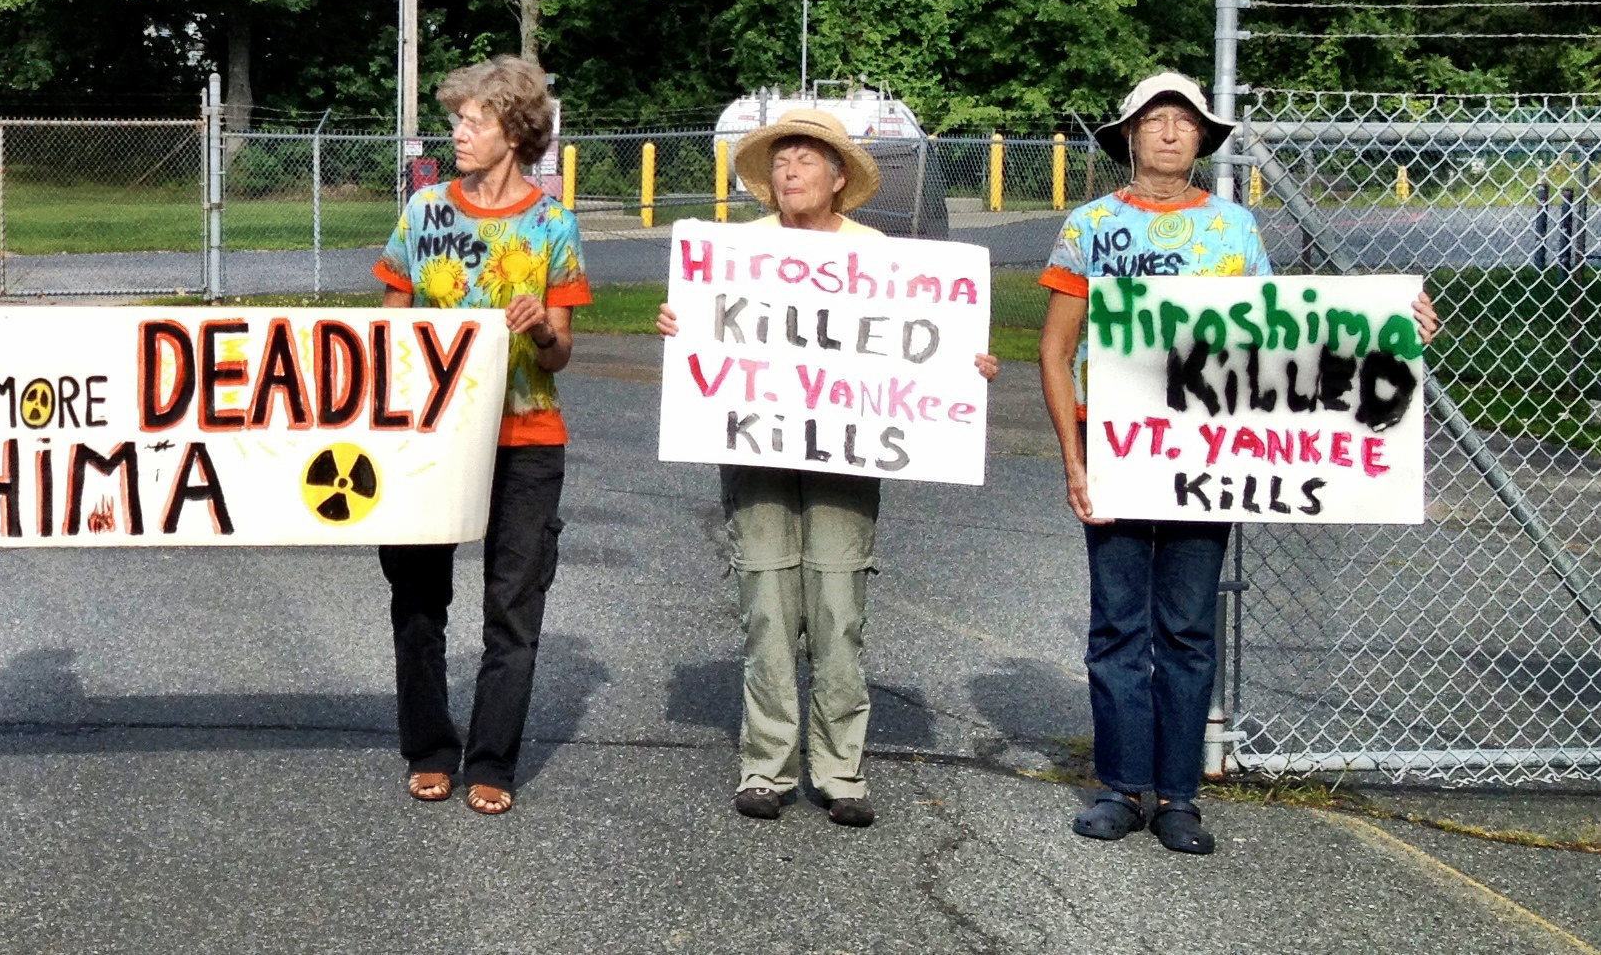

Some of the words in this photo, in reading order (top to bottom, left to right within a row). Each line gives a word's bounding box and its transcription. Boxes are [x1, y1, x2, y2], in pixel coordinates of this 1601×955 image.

[422, 204, 455, 231] NO
[416, 232, 487, 269] NUKES
[1092, 227, 1132, 263] NO
[1101, 251, 1189, 277] NUKES
[137, 317, 480, 434] DEADLY
[686, 352, 778, 403] VT.
[1102, 416, 1182, 460] VT.
[1197, 424, 1391, 478] YANKEE
